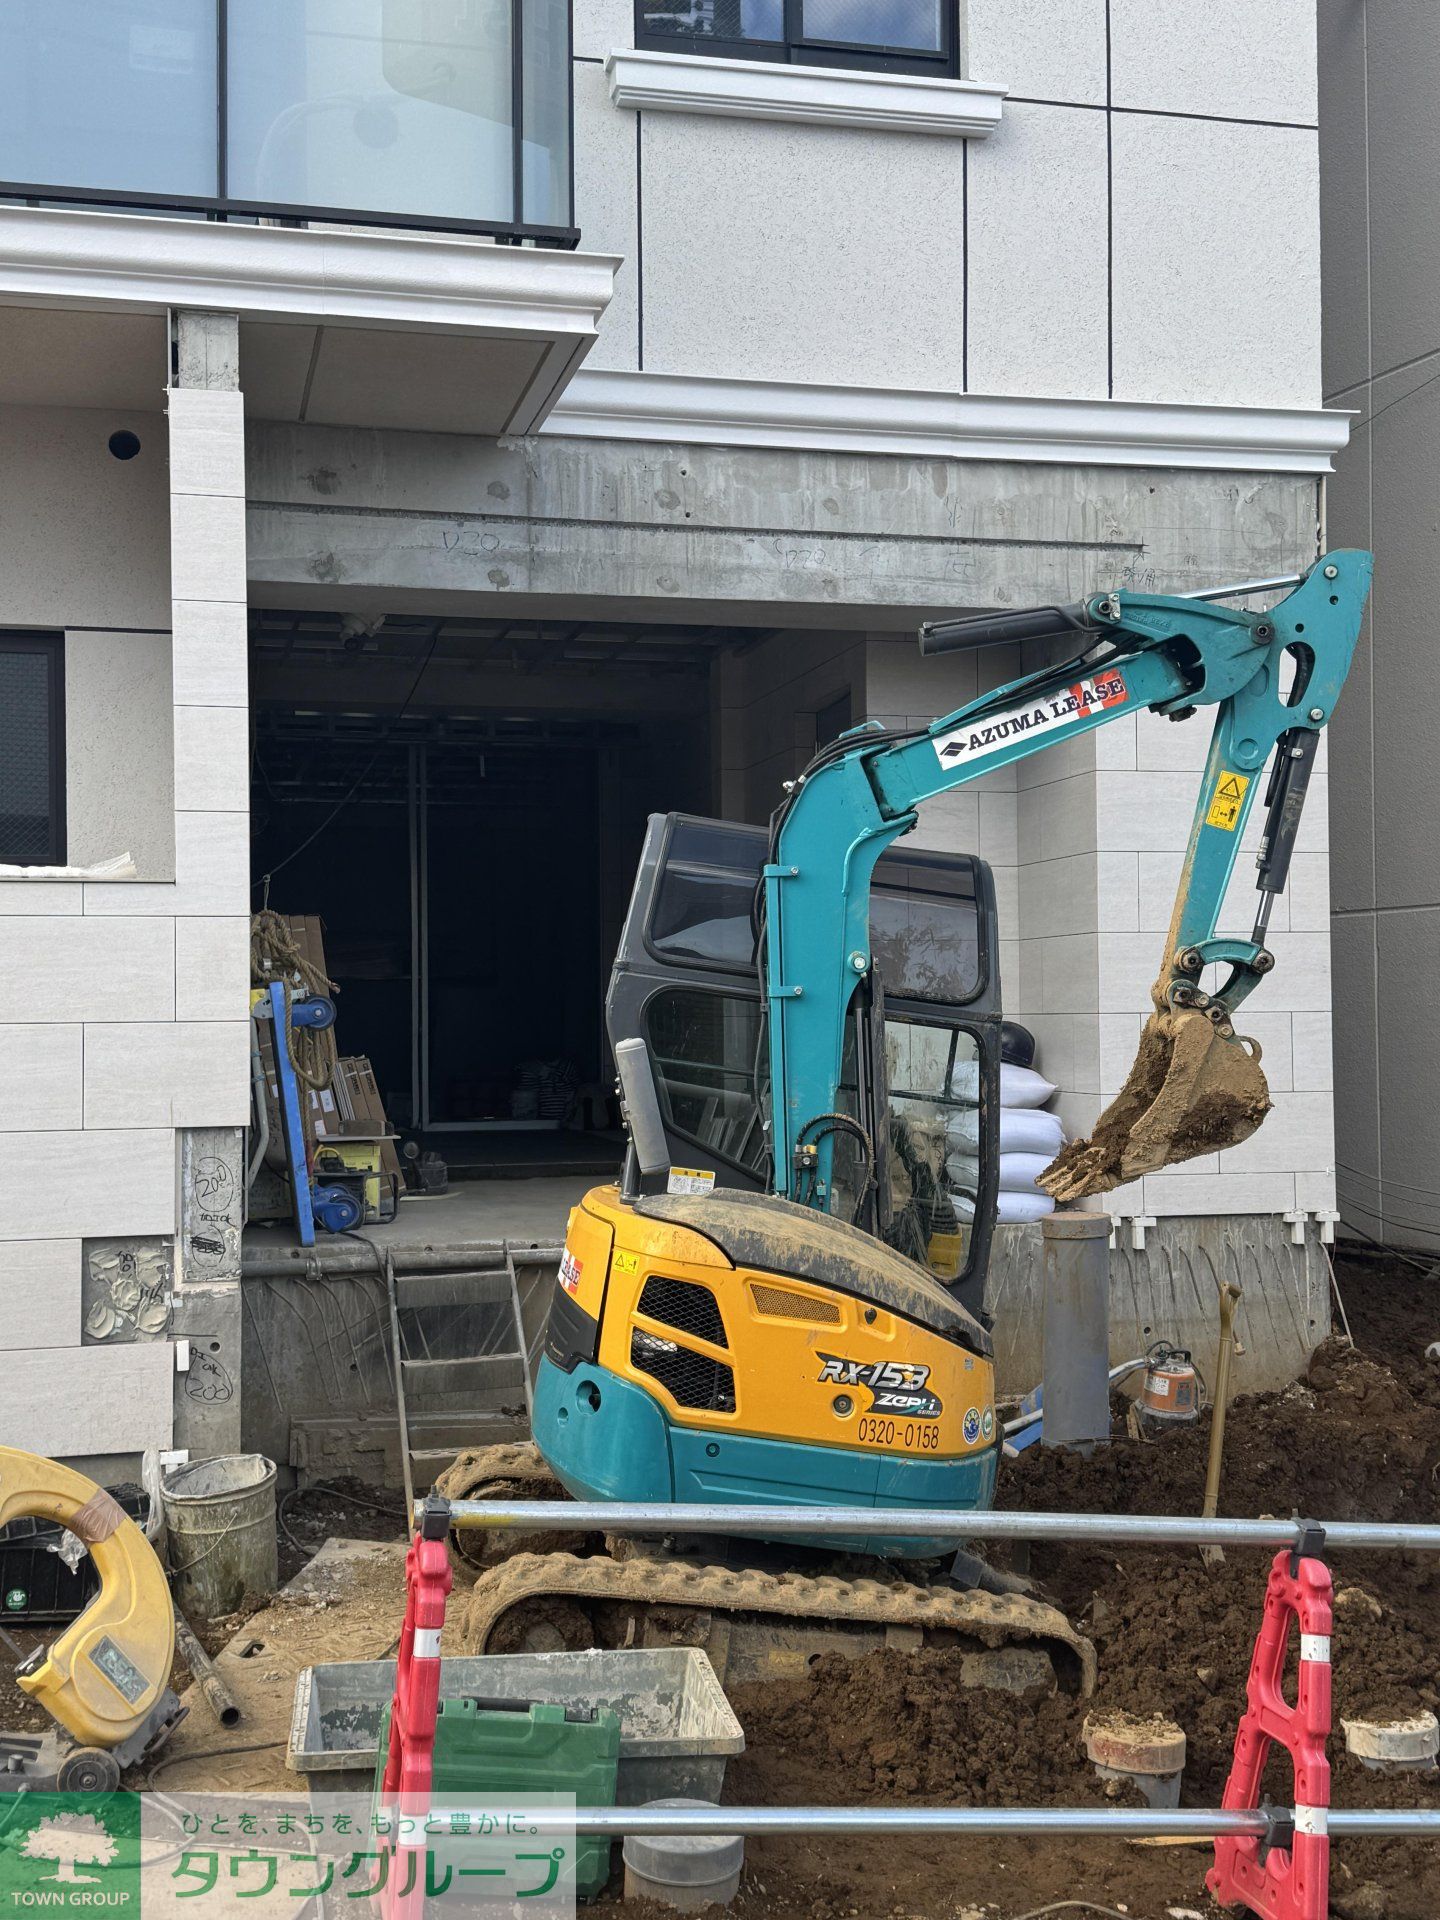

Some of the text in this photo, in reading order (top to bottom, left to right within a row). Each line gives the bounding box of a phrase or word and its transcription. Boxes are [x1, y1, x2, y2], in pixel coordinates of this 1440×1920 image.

[968, 678, 1125, 751] AZUMA LEASE
[858, 1417, 939, 1450] 0320-0158
